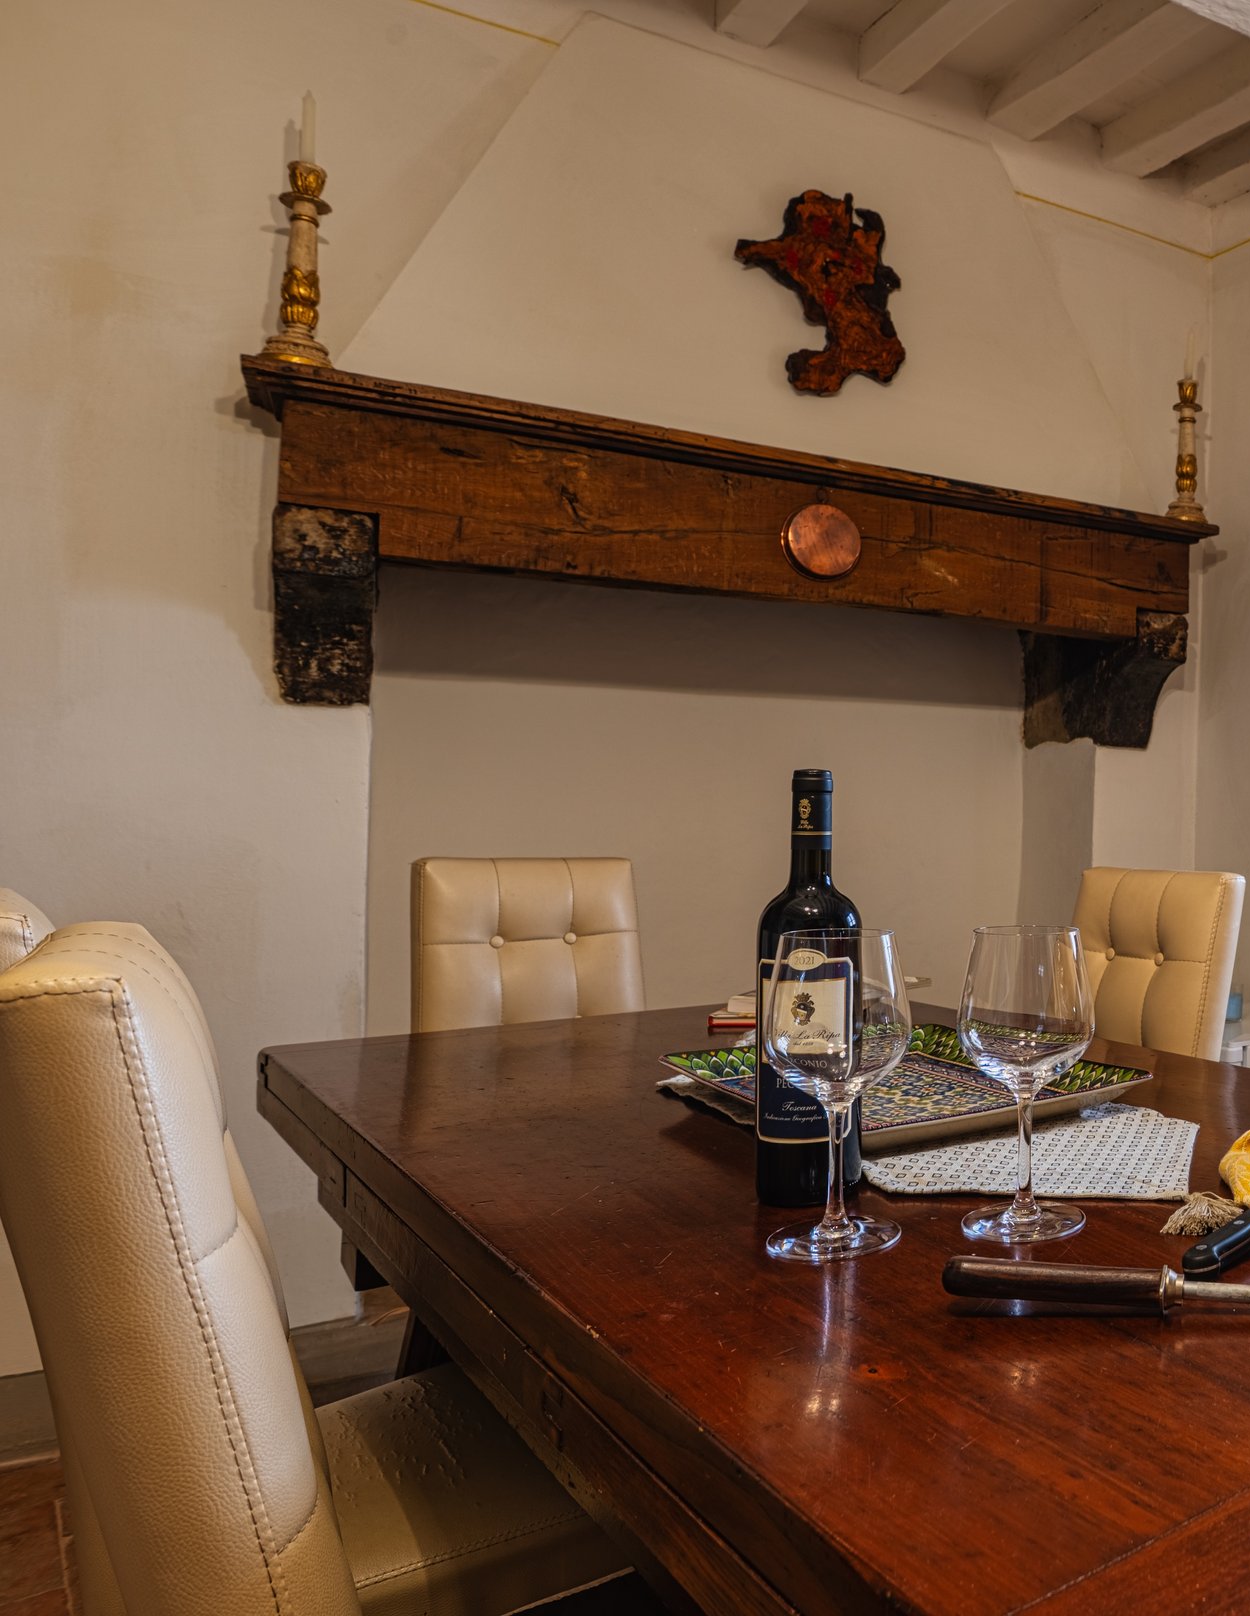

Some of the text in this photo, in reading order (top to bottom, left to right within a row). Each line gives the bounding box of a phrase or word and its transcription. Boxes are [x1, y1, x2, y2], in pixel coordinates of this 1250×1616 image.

[794, 956, 815, 965] 2021
[792, 1030, 810, 1040] La
[812, 1029, 841, 1041] Ripa
[782, 1101, 817, 1111] Toscana
